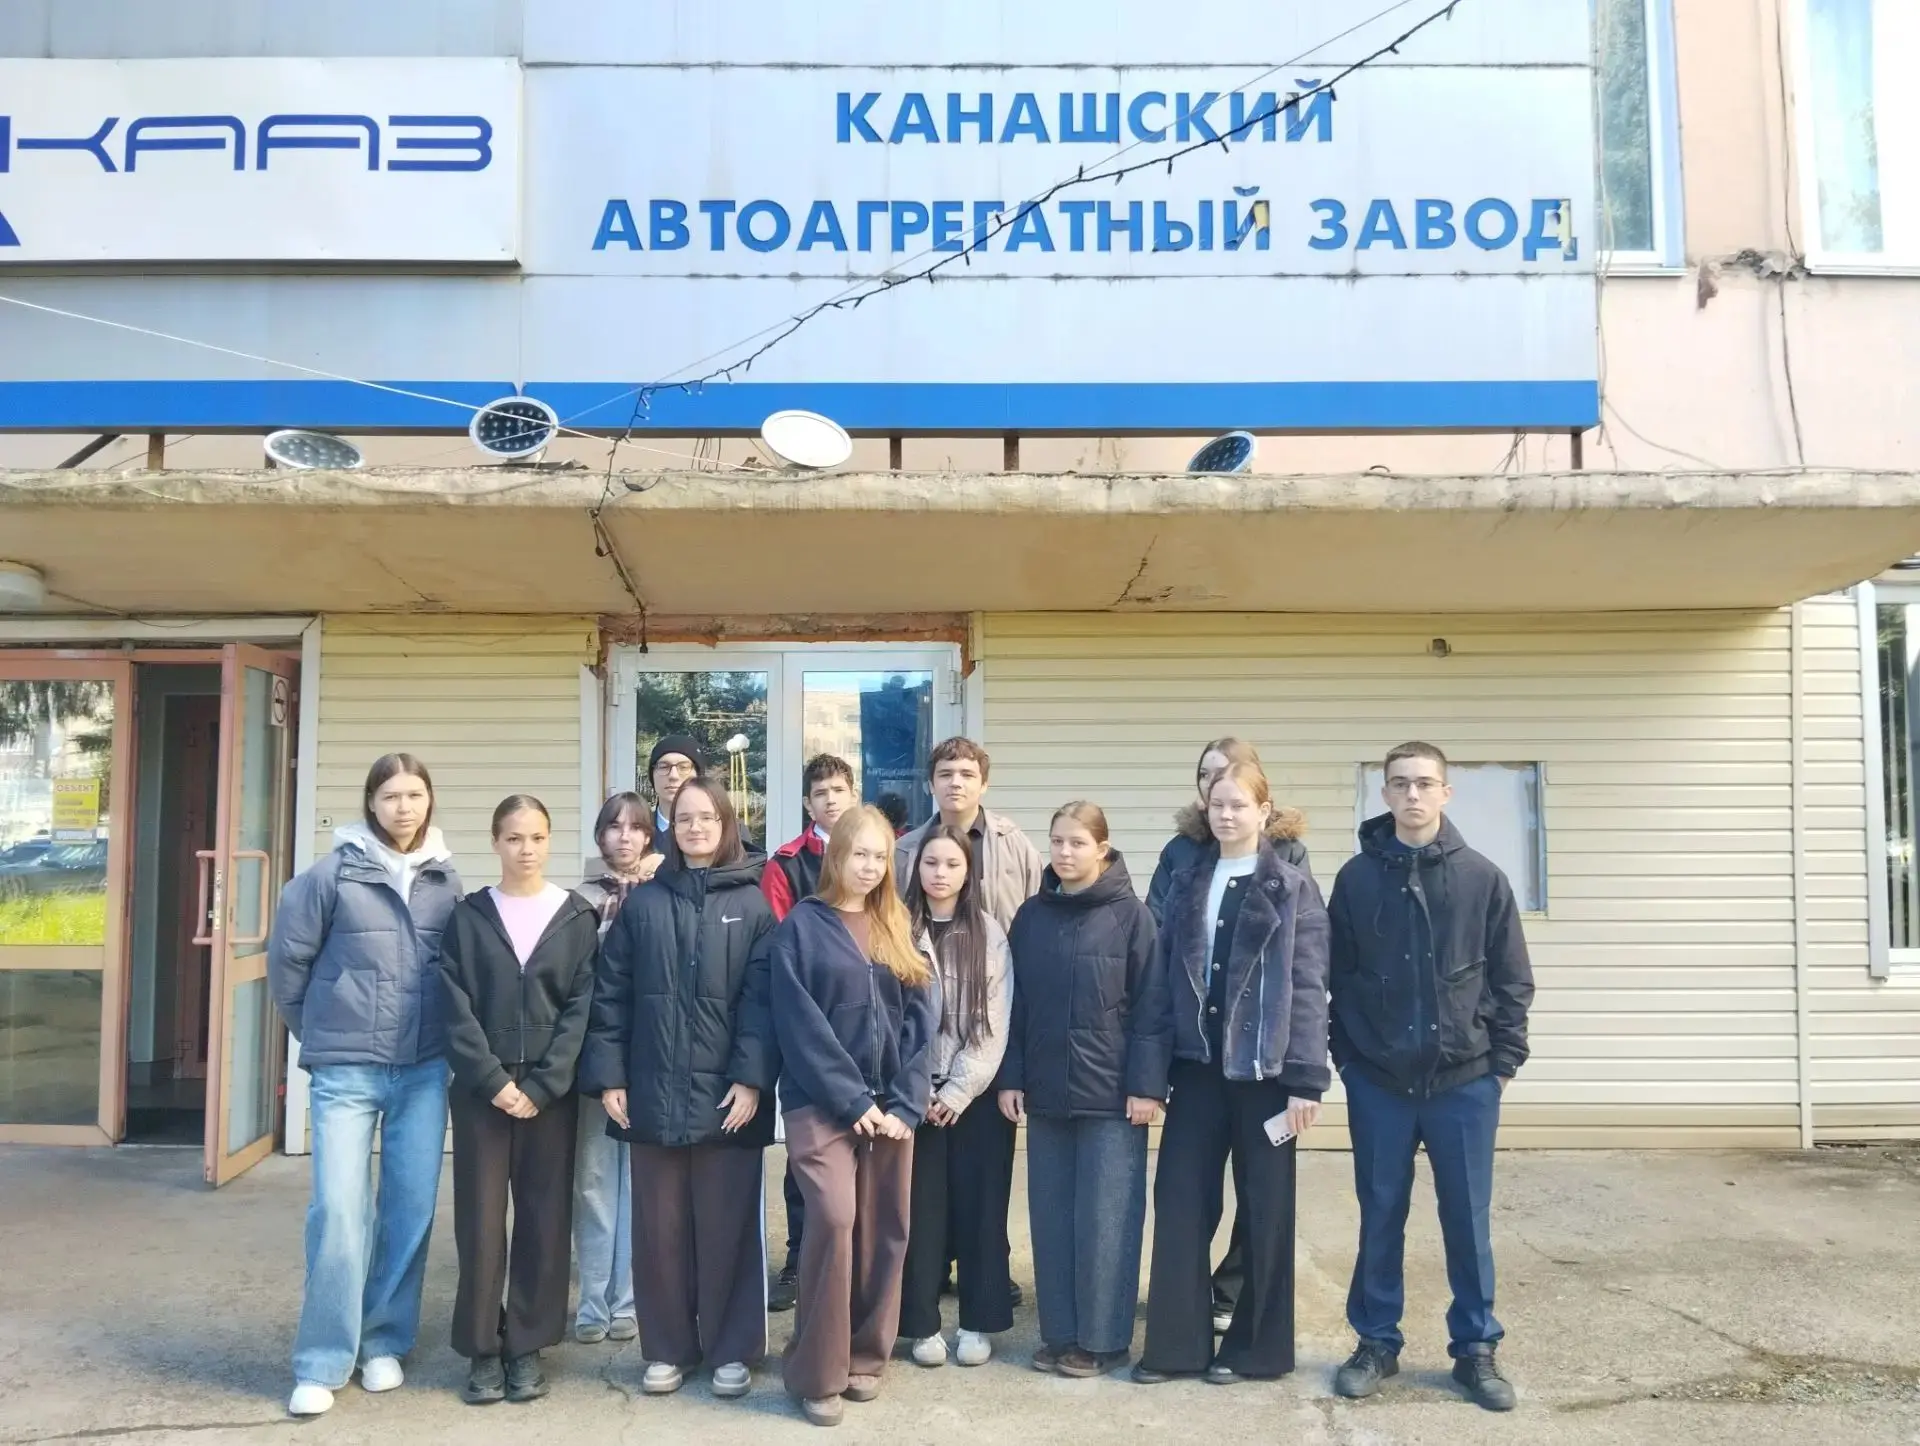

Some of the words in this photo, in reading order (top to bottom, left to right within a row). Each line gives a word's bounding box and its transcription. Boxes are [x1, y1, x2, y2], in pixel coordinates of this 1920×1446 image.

[836, 78, 1333, 144] КАНАШСКИЙ
[592, 186, 1270, 252] АВТОАГРЕГАТНЫЙ
[1307, 197, 1578, 261] ЗАВОД
